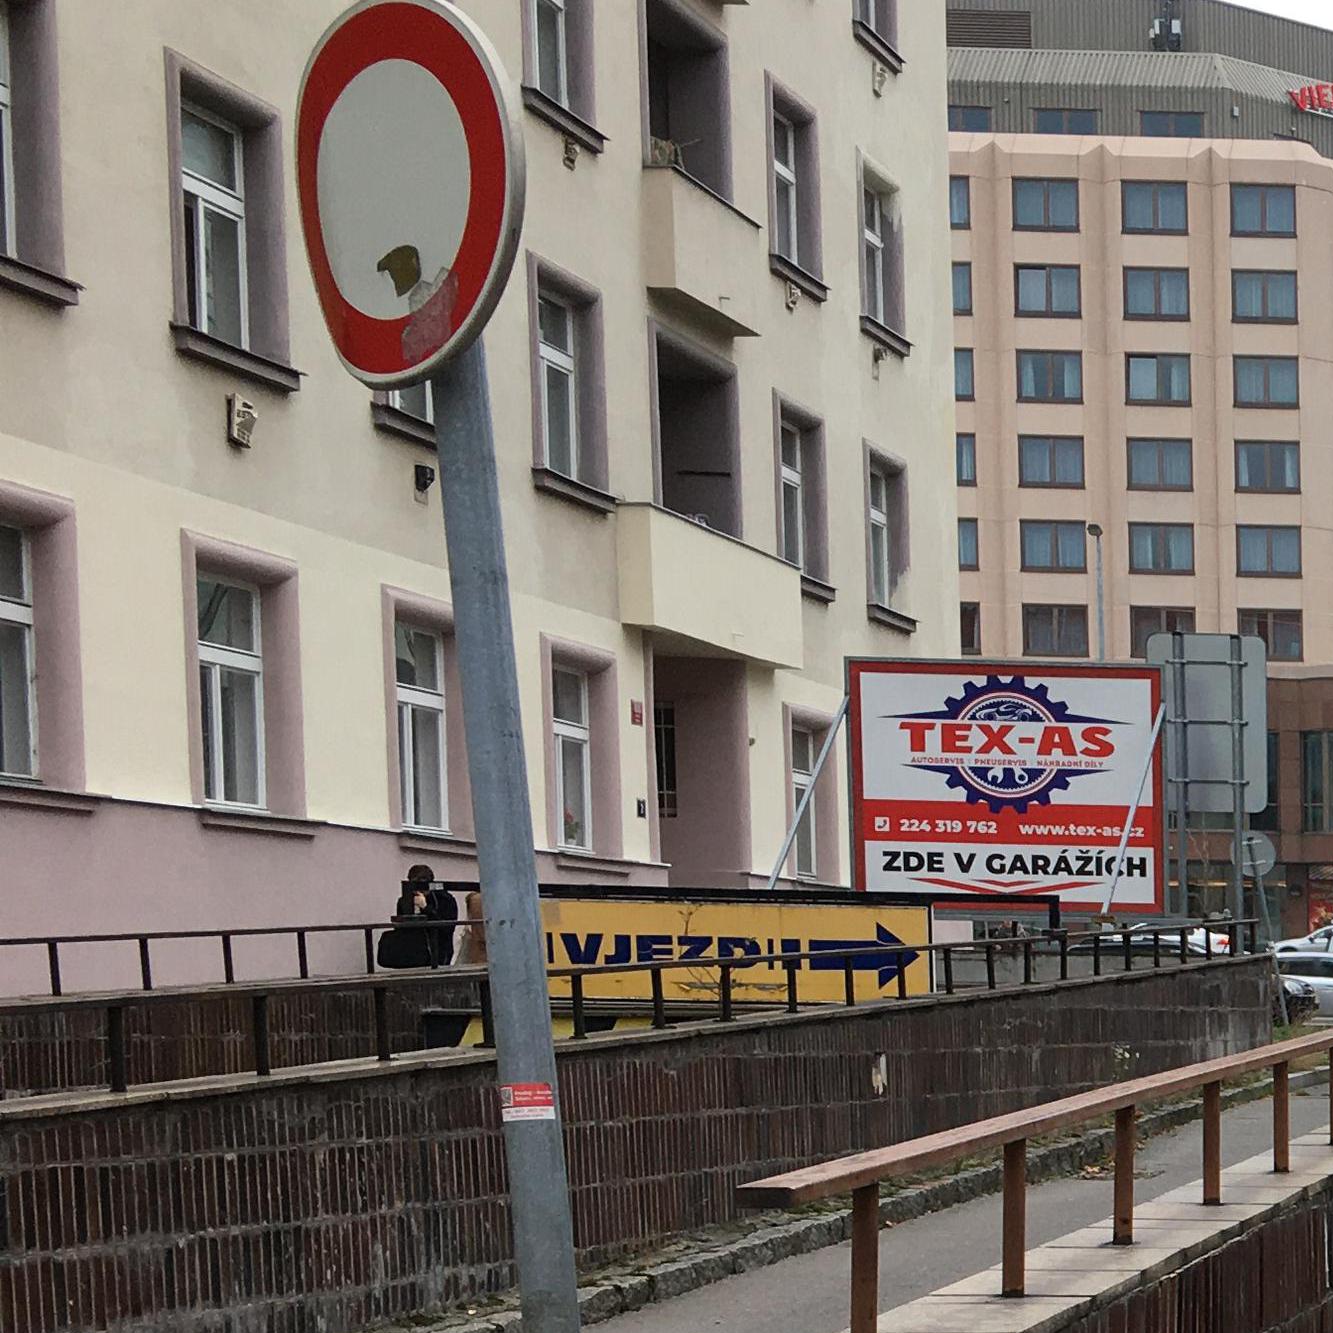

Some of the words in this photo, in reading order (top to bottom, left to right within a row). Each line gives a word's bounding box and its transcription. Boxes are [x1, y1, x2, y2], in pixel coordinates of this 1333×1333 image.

[899, 721, 1116, 758] TEX-AS
[911, 756, 965, 765] AUTOSERVIS
[974, 758, 1027, 767] PNEUSERVIS
[899, 818, 931, 832] 224
[934, 820, 963, 833] 319
[966, 820, 998, 834] 762
[882, 851, 945, 872] ZDE
[953, 852, 977, 873] V
[985, 848, 1147, 877] GARÁŽÍCH
[560, 932, 762, 969] VJEZD
